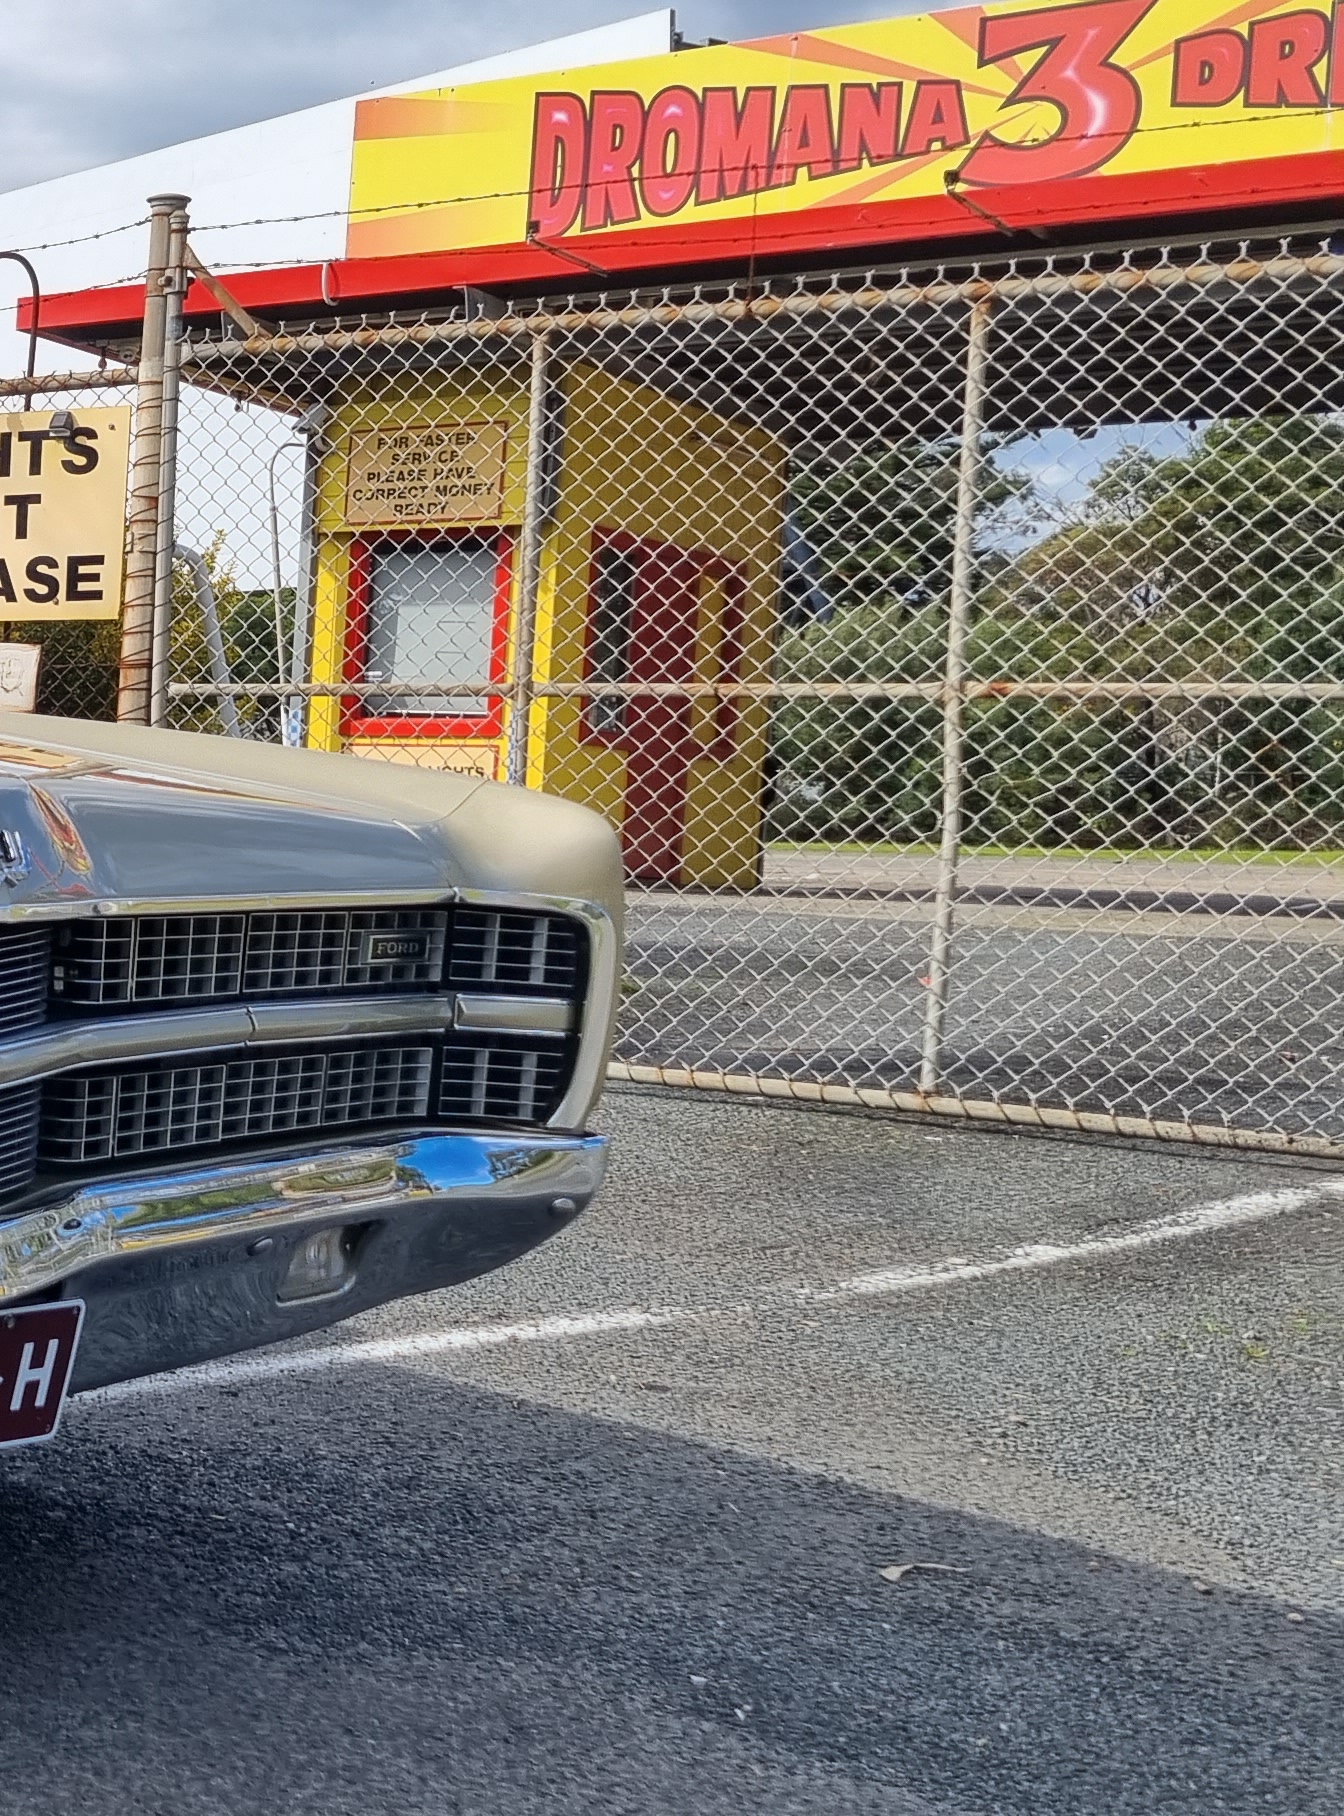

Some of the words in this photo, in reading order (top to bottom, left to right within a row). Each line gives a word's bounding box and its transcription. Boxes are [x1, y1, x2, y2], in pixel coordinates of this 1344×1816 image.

[528, 78, 970, 240] DROMANA
[953, 0, 1159, 187] 3
[377, 437, 409, 450] FOR
[418, 432, 476, 448] FASTER
[367, 469, 427, 484] PLEASE
[433, 466, 476, 480] HAVE
[352, 486, 428, 502] CORRECT
[434, 483, 495, 499] MONEY
[393, 502, 449, 517] READY
[377, 941, 419, 955] FORD
